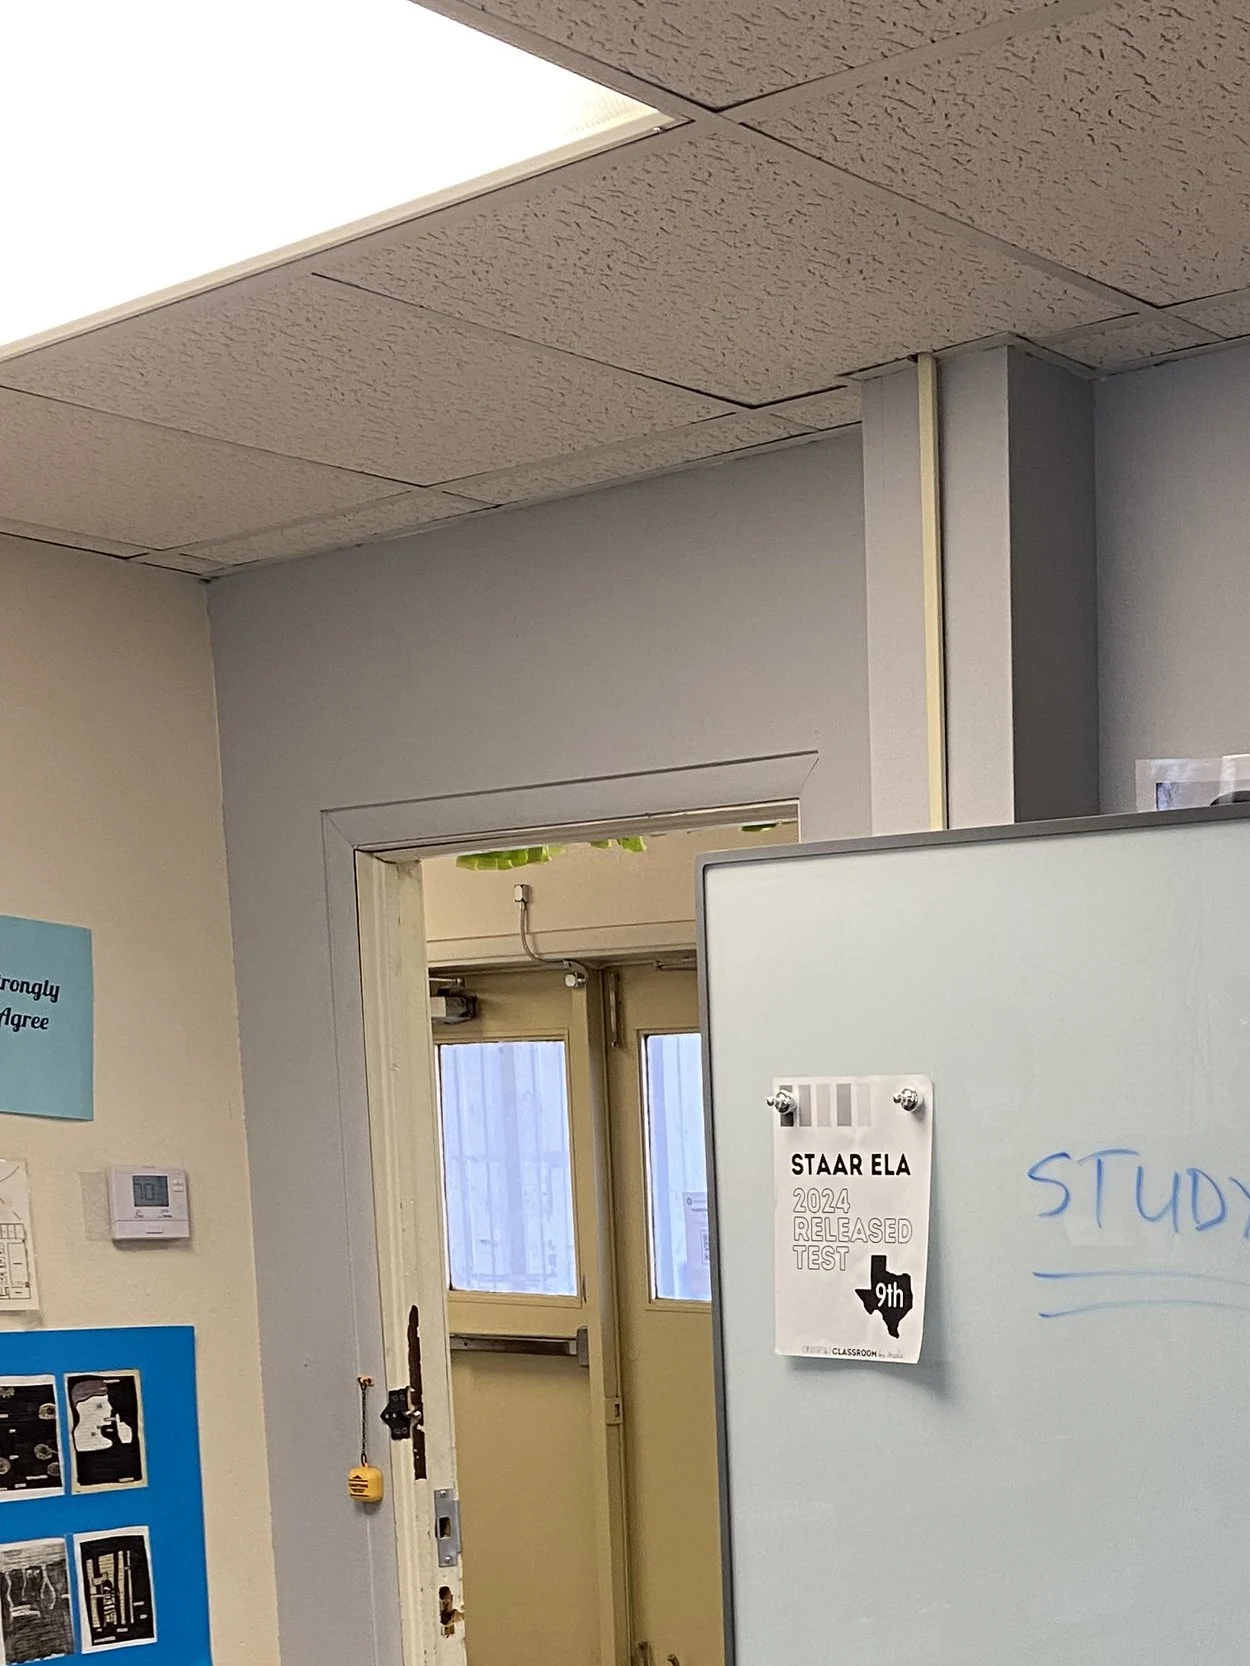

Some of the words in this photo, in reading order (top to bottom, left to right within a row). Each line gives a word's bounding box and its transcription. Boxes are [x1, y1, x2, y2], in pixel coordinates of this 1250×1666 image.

[0, 976, 60, 1003] rongly
[0, 1007, 49, 1032] Agree
[791, 1153, 863, 1176] STAAR
[871, 1153, 912, 1176] ELA
[793, 1187, 851, 1214] 2024
[793, 1216, 913, 1245] RELEASED
[792, 1245, 850, 1271] TEST
[875, 1282, 904, 1308] 9th
[832, 1347, 877, 1358] CLASSROOM
